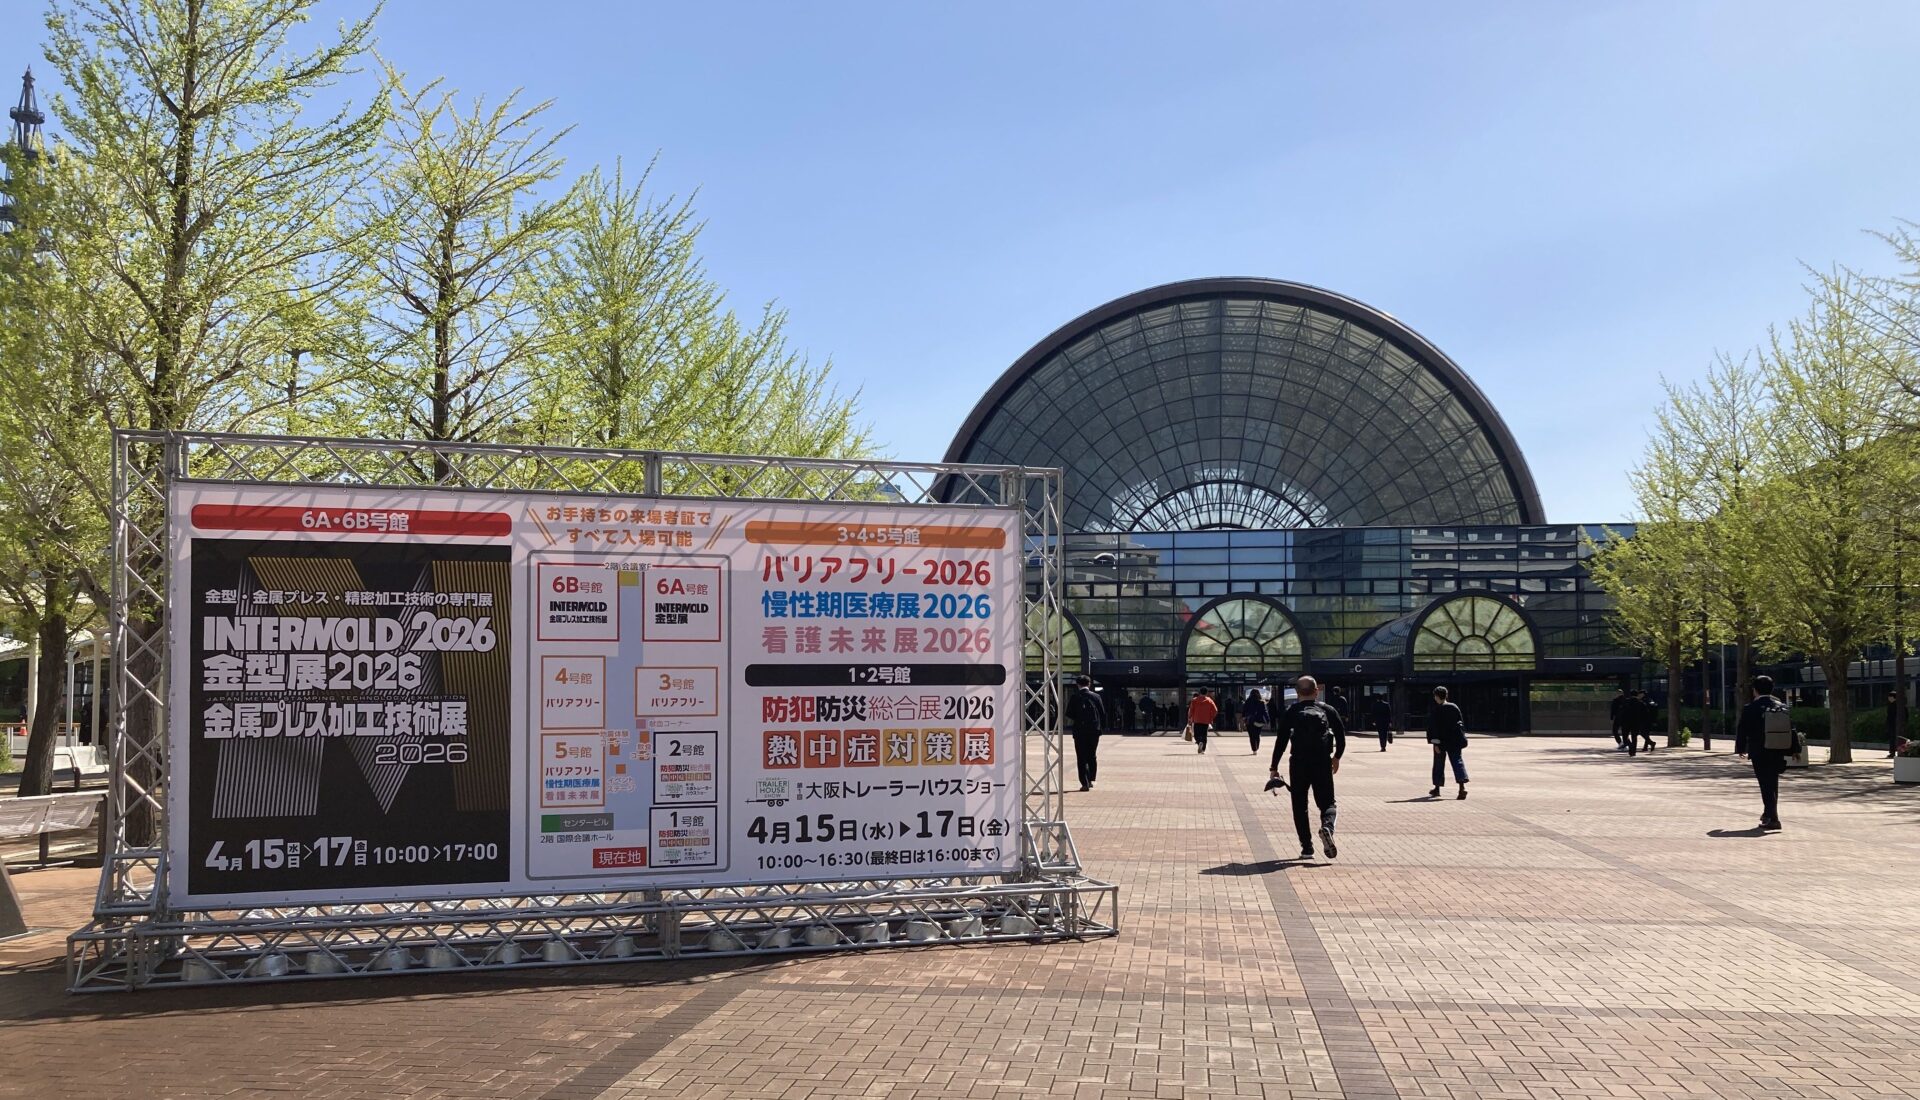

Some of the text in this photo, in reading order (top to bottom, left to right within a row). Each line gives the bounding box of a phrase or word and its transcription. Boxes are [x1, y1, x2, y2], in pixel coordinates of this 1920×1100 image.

[301, 511, 409, 532] 6A・6B号館
[546, 507, 711, 526] お手持ちの来場者証で
[566, 528, 693, 547] すべて入場可能
[837, 526, 920, 545] 3・4・5号館
[762, 555, 991, 586] バリアフリー2026
[552, 576, 603, 594] 6B号館
[656, 578, 709, 595] 6A号館
[205, 589, 493, 608] 金型・金属プレス・精密加工技術の専門展
[549, 601, 608, 612] INTERMOLD
[761, 590, 991, 619] 慢性期医療展2026
[655, 603, 709, 614] INTERMOLD
[655, 613, 688, 625] 金型展
[203, 611, 497, 652] INTERMOLD 2026
[761, 626, 991, 654] 看護未来展2026
[202, 652, 422, 692] 金型展2026
[555, 667, 592, 685] 4号館
[848, 667, 911, 684] 1・2号館
[1133, 665, 1140, 674] B
[1354, 664, 1362, 673] C
[1586, 663, 1594, 672] D
[659, 674, 695, 690] 3号館
[546, 697, 600, 708] バリアフリー
[651, 697, 704, 708] バリアフリー
[762, 695, 994, 723] 防犯防災総合展2026
[203, 700, 468, 738] 金属プレス加工技術展
[375, 743, 468, 765] 2026
[555, 742, 592, 759] 5号館
[669, 740, 705, 756] 2号館
[766, 732, 992, 766] 熱中症対策展
[546, 766, 599, 776] バリアフリー
[805, 778, 1006, 800] 大阪トレーラーハウスショー
[563, 818, 609, 828] センタービル
[670, 811, 704, 828] 1号館
[373, 845, 430, 865] 10:00
[443, 843, 498, 862] 17:00
[598, 850, 642, 865] 現在地
